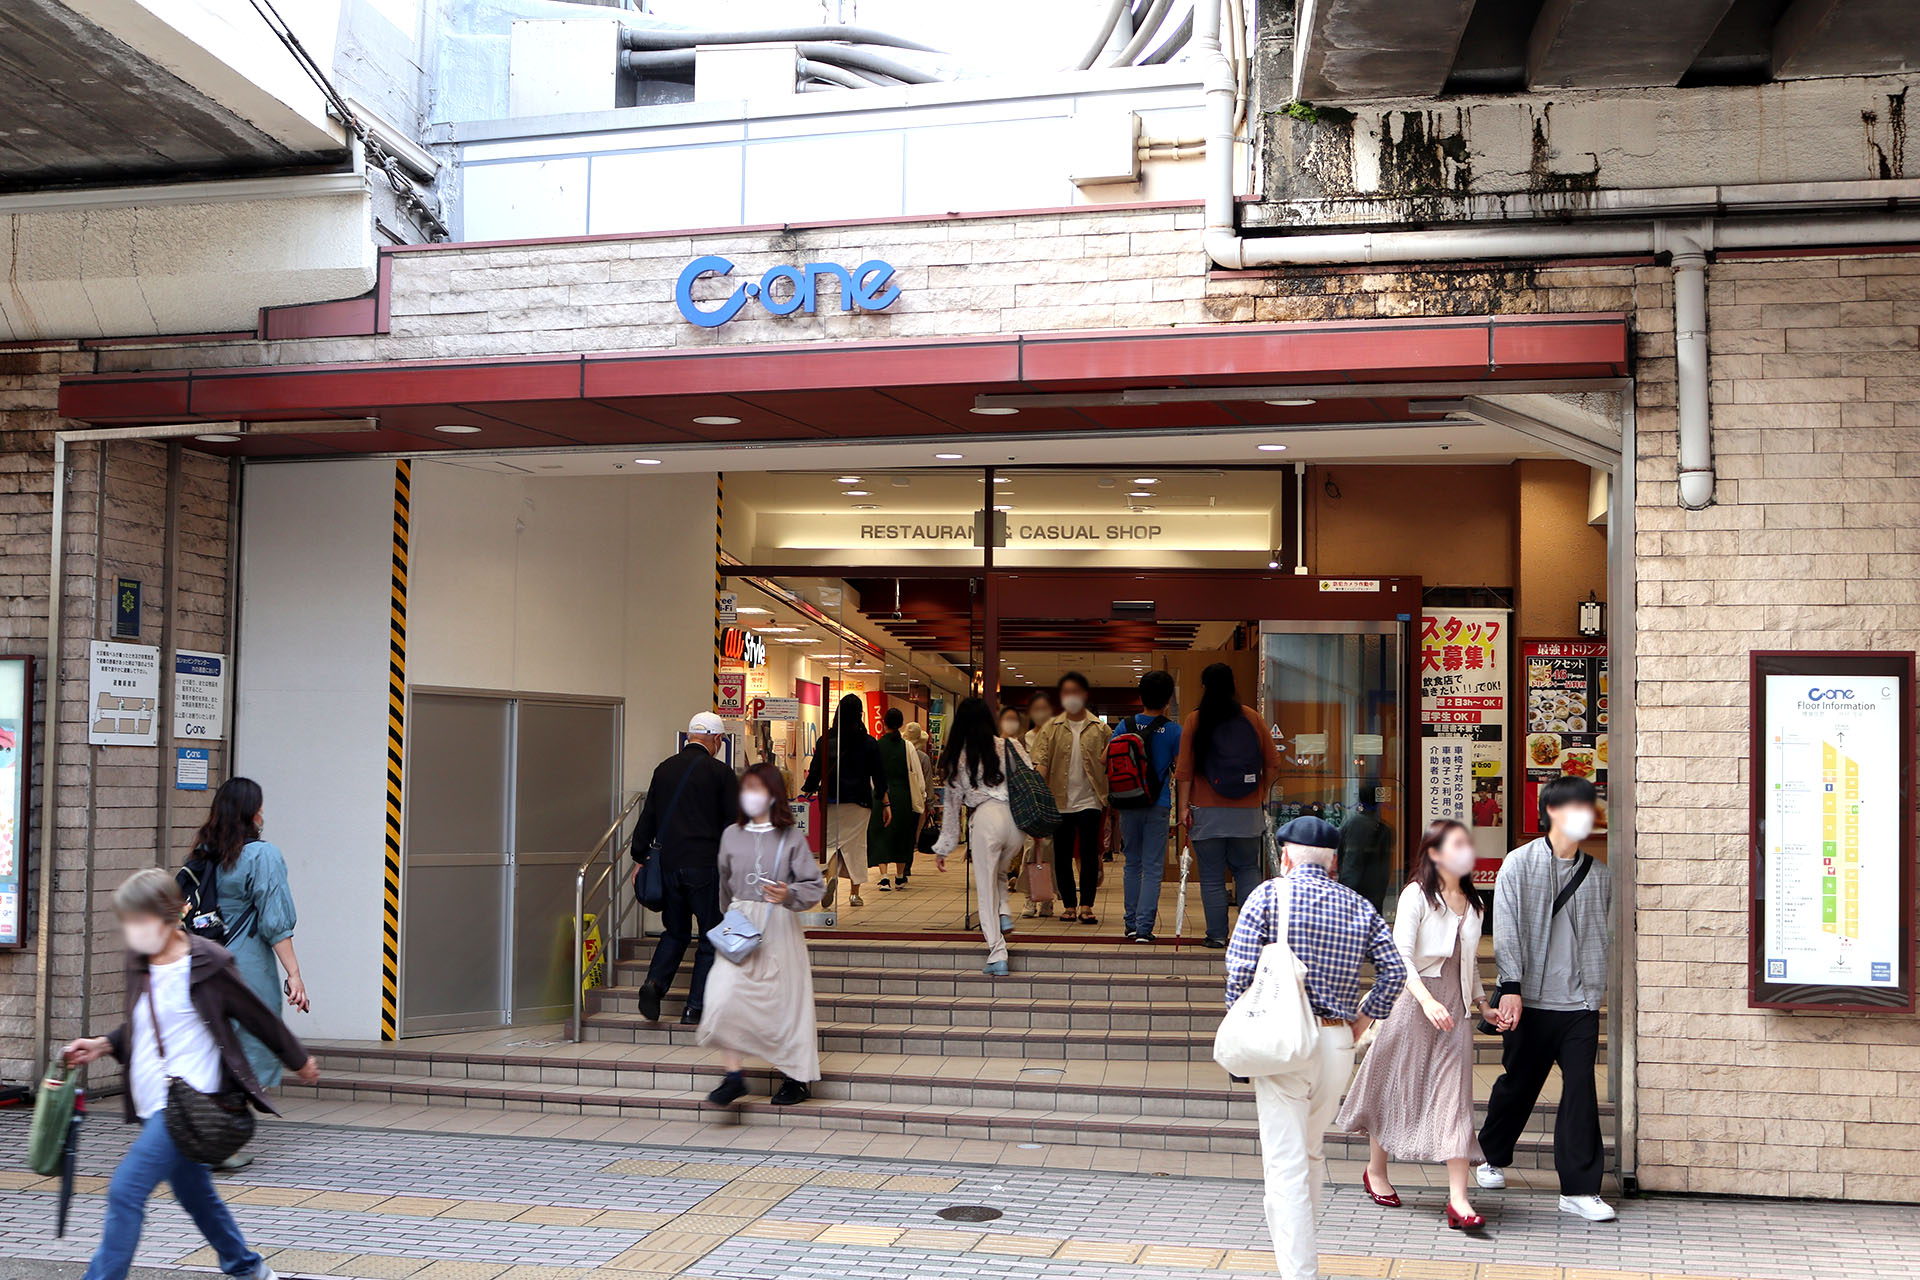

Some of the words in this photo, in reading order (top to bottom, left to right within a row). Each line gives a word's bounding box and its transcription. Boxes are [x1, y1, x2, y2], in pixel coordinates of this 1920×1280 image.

[861, 525, 975, 539] RESTAURAN
[1019, 525, 1099, 540] CASUAL
[1106, 525, 1162, 540] SHOP
[1421, 616, 1501, 642] スタッフ
[1423, 674, 1463, 687] 飲食店で
[753, 698, 766, 719] P
[1797, 701, 1820, 710] Floor
[1822, 701, 1876, 711] Information
